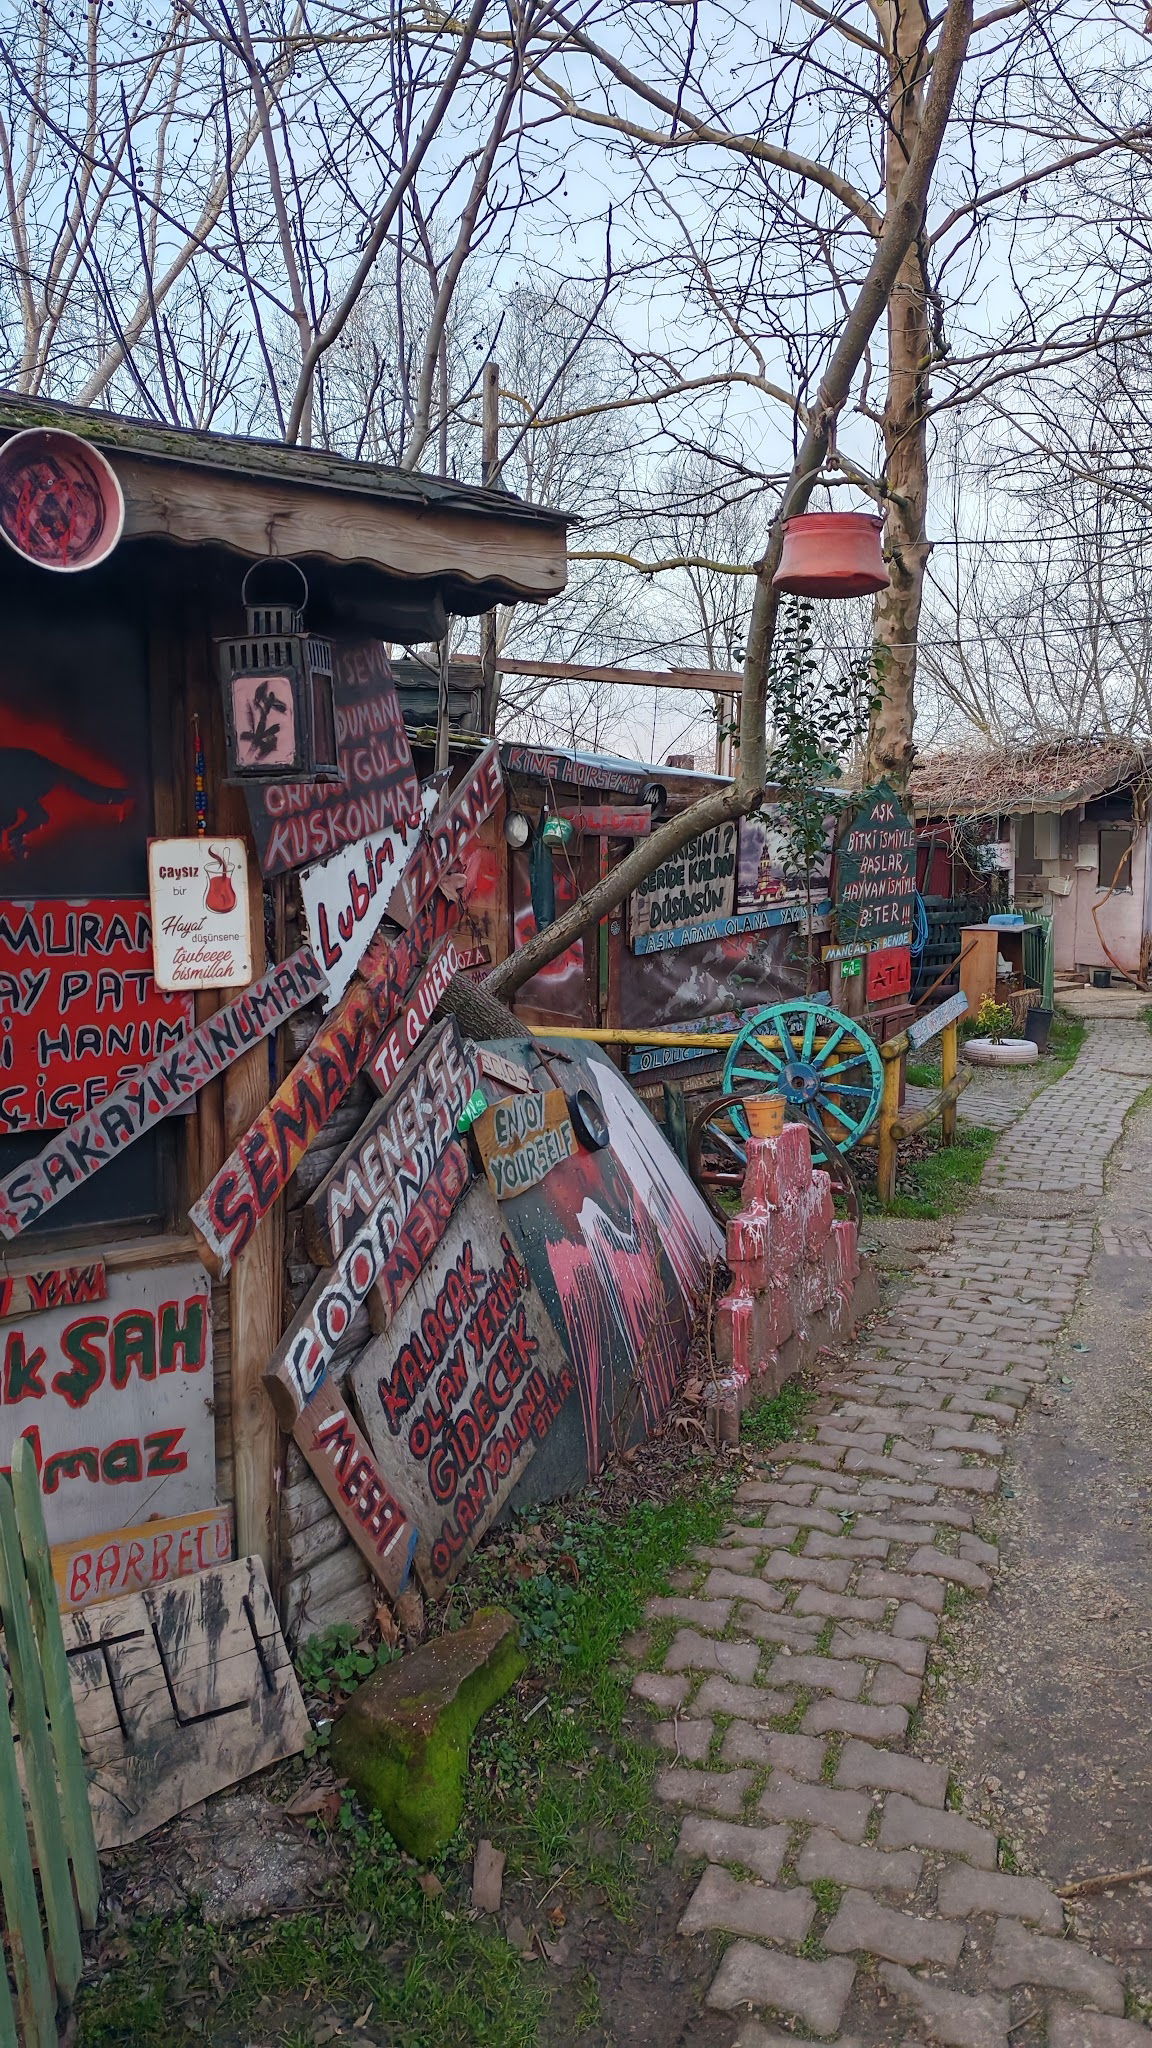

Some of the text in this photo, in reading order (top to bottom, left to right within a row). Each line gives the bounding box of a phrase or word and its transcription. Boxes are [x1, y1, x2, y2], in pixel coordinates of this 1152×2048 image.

[507, 747, 559, 780] KING
[869, 803, 895, 822] AŞK
[172, 886, 187, 896] bir
[842, 880, 886, 903] HAYVAN
[161, 915, 208, 939] Hayat
[724, 911, 770, 936] OLANA
[191, 933, 240, 945] düşünsene
[882, 932, 909, 949] BENDE
[172, 960, 235, 981] bismillah
[374, 1030, 406, 1088] TE
[488, 1120, 575, 1196] YOURSELF
[284, 1195, 402, 1408] GOOD
[377, 1239, 487, 1435] KALACAK
[408, 1340, 469, 1460] OLAN
[427, 1303, 539, 1506] GİDECEK
[430, 1466, 490, 1577] OLAN
